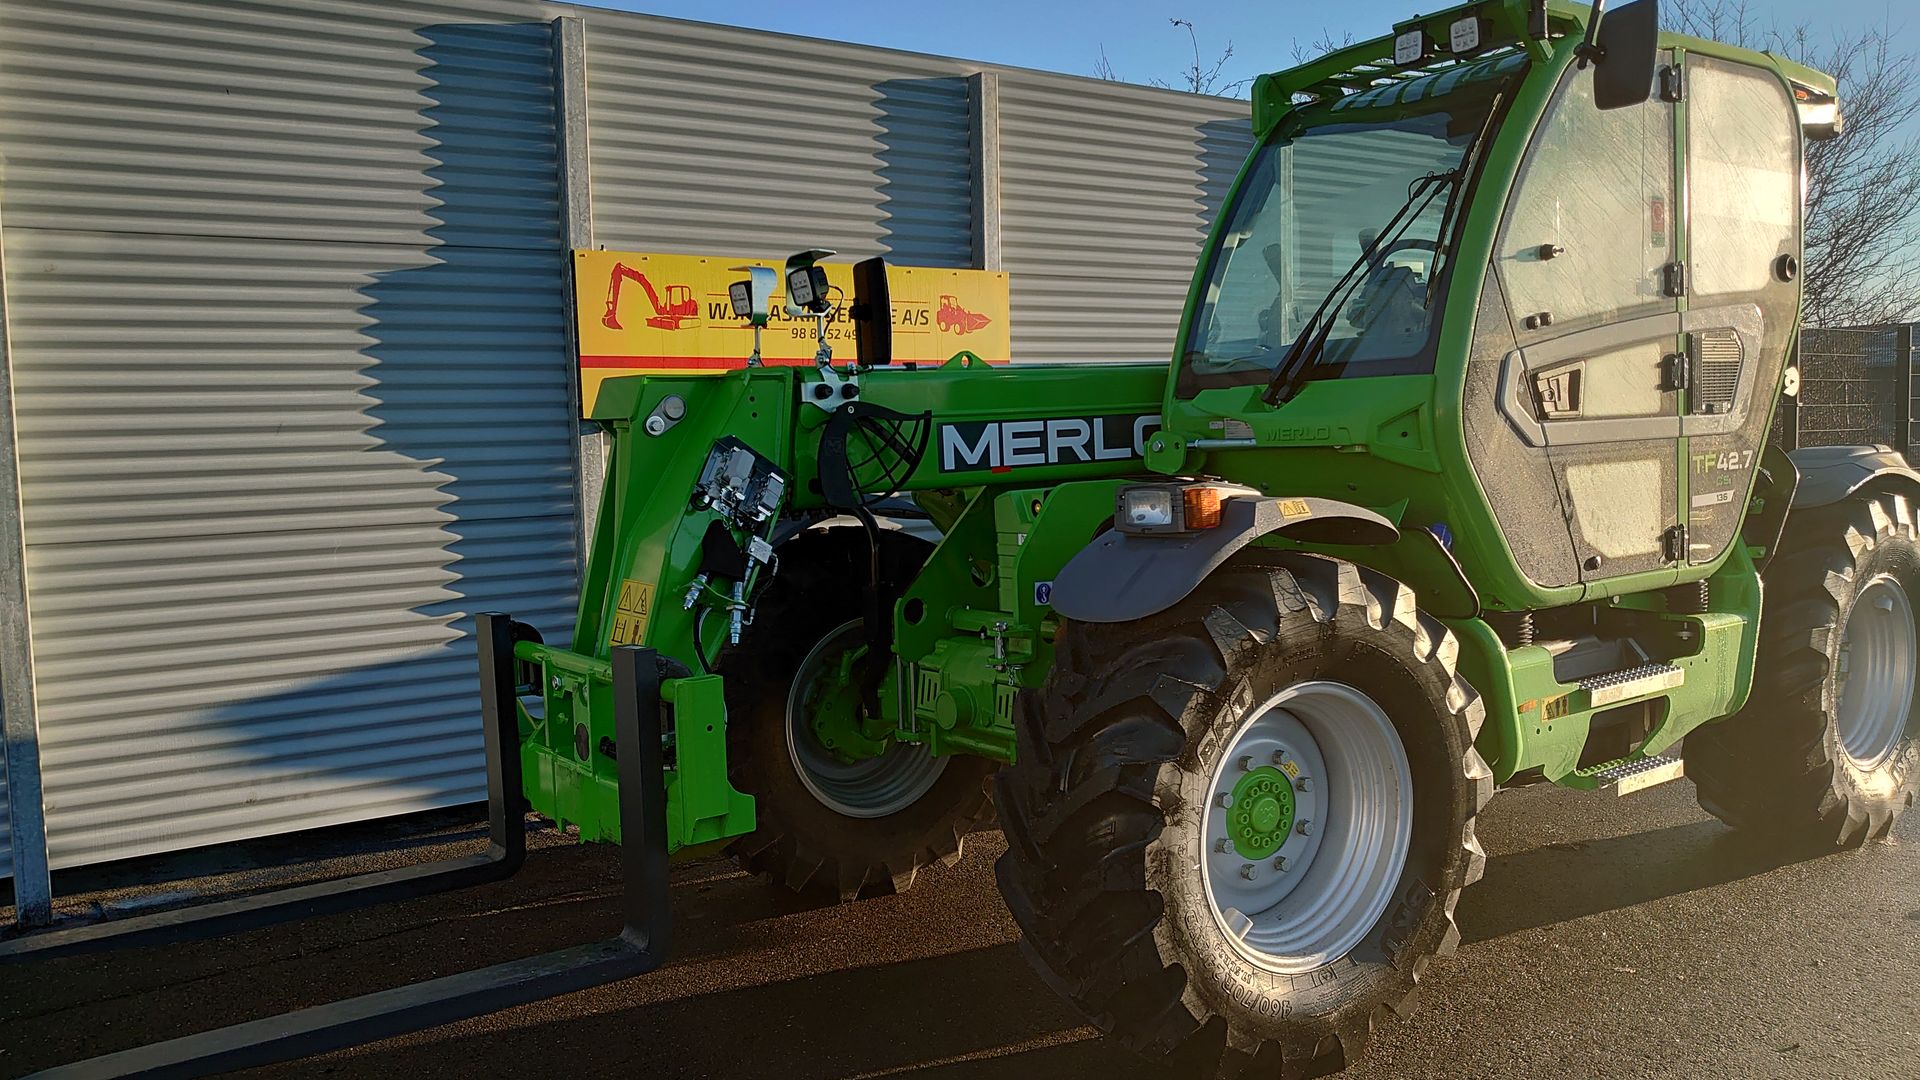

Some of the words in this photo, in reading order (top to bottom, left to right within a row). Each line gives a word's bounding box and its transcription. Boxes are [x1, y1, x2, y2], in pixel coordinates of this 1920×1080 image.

[901, 309, 930, 326] A/S
[791, 327, 807, 339] 98
[827, 329, 841, 340] 52
[1266, 426, 1331, 442] MERLO
[1692, 450, 1753, 474] TF42.7
